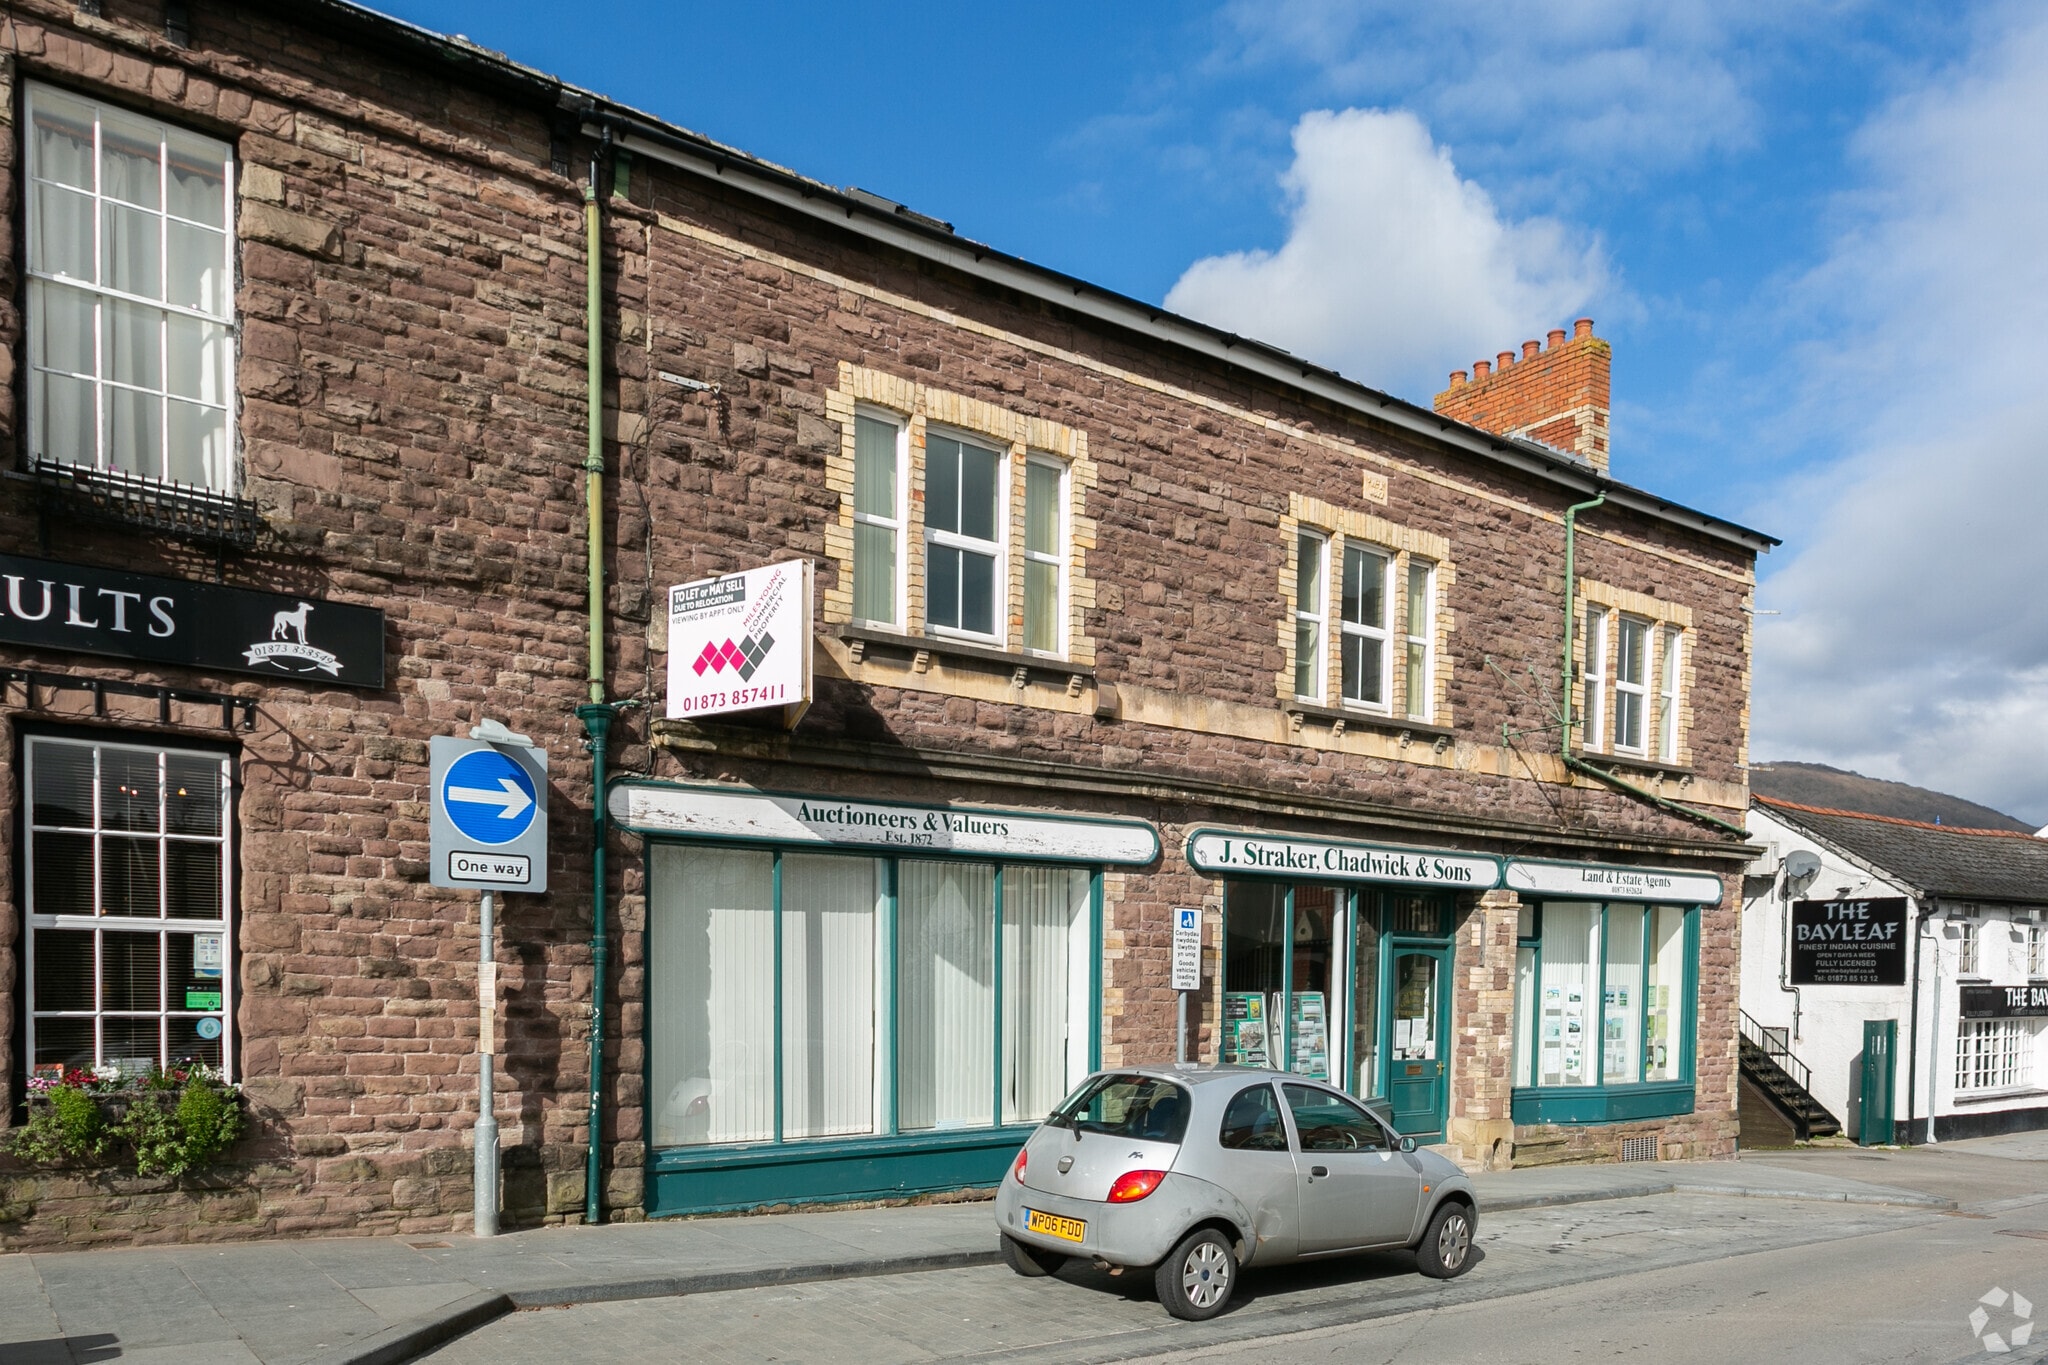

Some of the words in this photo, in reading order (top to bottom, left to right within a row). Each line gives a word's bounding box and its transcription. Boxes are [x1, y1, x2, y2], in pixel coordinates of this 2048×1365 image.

[674, 591, 685, 603] TO
[686, 588, 700, 601] LET
[700, 588, 708, 597] or
[709, 582, 726, 596] MAY
[726, 579, 744, 592] SELL
[743, 601, 762, 627] MILES
[759, 568, 782, 601] YOUNG
[0, 574, 176, 638] ULTS
[674, 603, 686, 613] DUE
[695, 594, 734, 608] RELOCATION
[749, 577, 787, 633] COMMERCIAL
[672, 613, 698, 625] VIEWING
[727, 605, 745, 615] ONLY
[753, 594, 784, 640] PROPERTY
[254, 644, 288, 656] 01873
[683, 692, 726, 711] 01873
[731, 683, 785, 706] 857411
[796, 801, 917, 829] Auctioneers
[923, 812, 938, 831] &
[941, 813, 1009, 836] Valuers
[885, 830, 907, 844] Est.
[910, 833, 933, 845] 1872
[457, 859, 488, 873] One
[494, 863, 523, 877] way
[1219, 840, 1237, 864] J.
[1243, 842, 1320, 872] Straker,
[1324, 848, 1410, 877] Chadwick
[1415, 857, 1428, 878] &
[1433, 858, 1472, 882] Sons
[1581, 869, 1604, 883] Land
[1606, 873, 1614, 884] &
[1616, 872, 1643, 886] Estate
[1644, 874, 1672, 888] Agents
[1823, 902, 1870, 920] THE
[1796, 922, 1899, 941] BAYLEAF
[1799, 943, 1827, 951] FINEST
[1860, 942, 1896, 950] CUISINE
[2005, 987, 2028, 1007] THE
[1031, 1212, 1058, 1232] WP06
[1060, 1220, 1082, 1238] FDD
